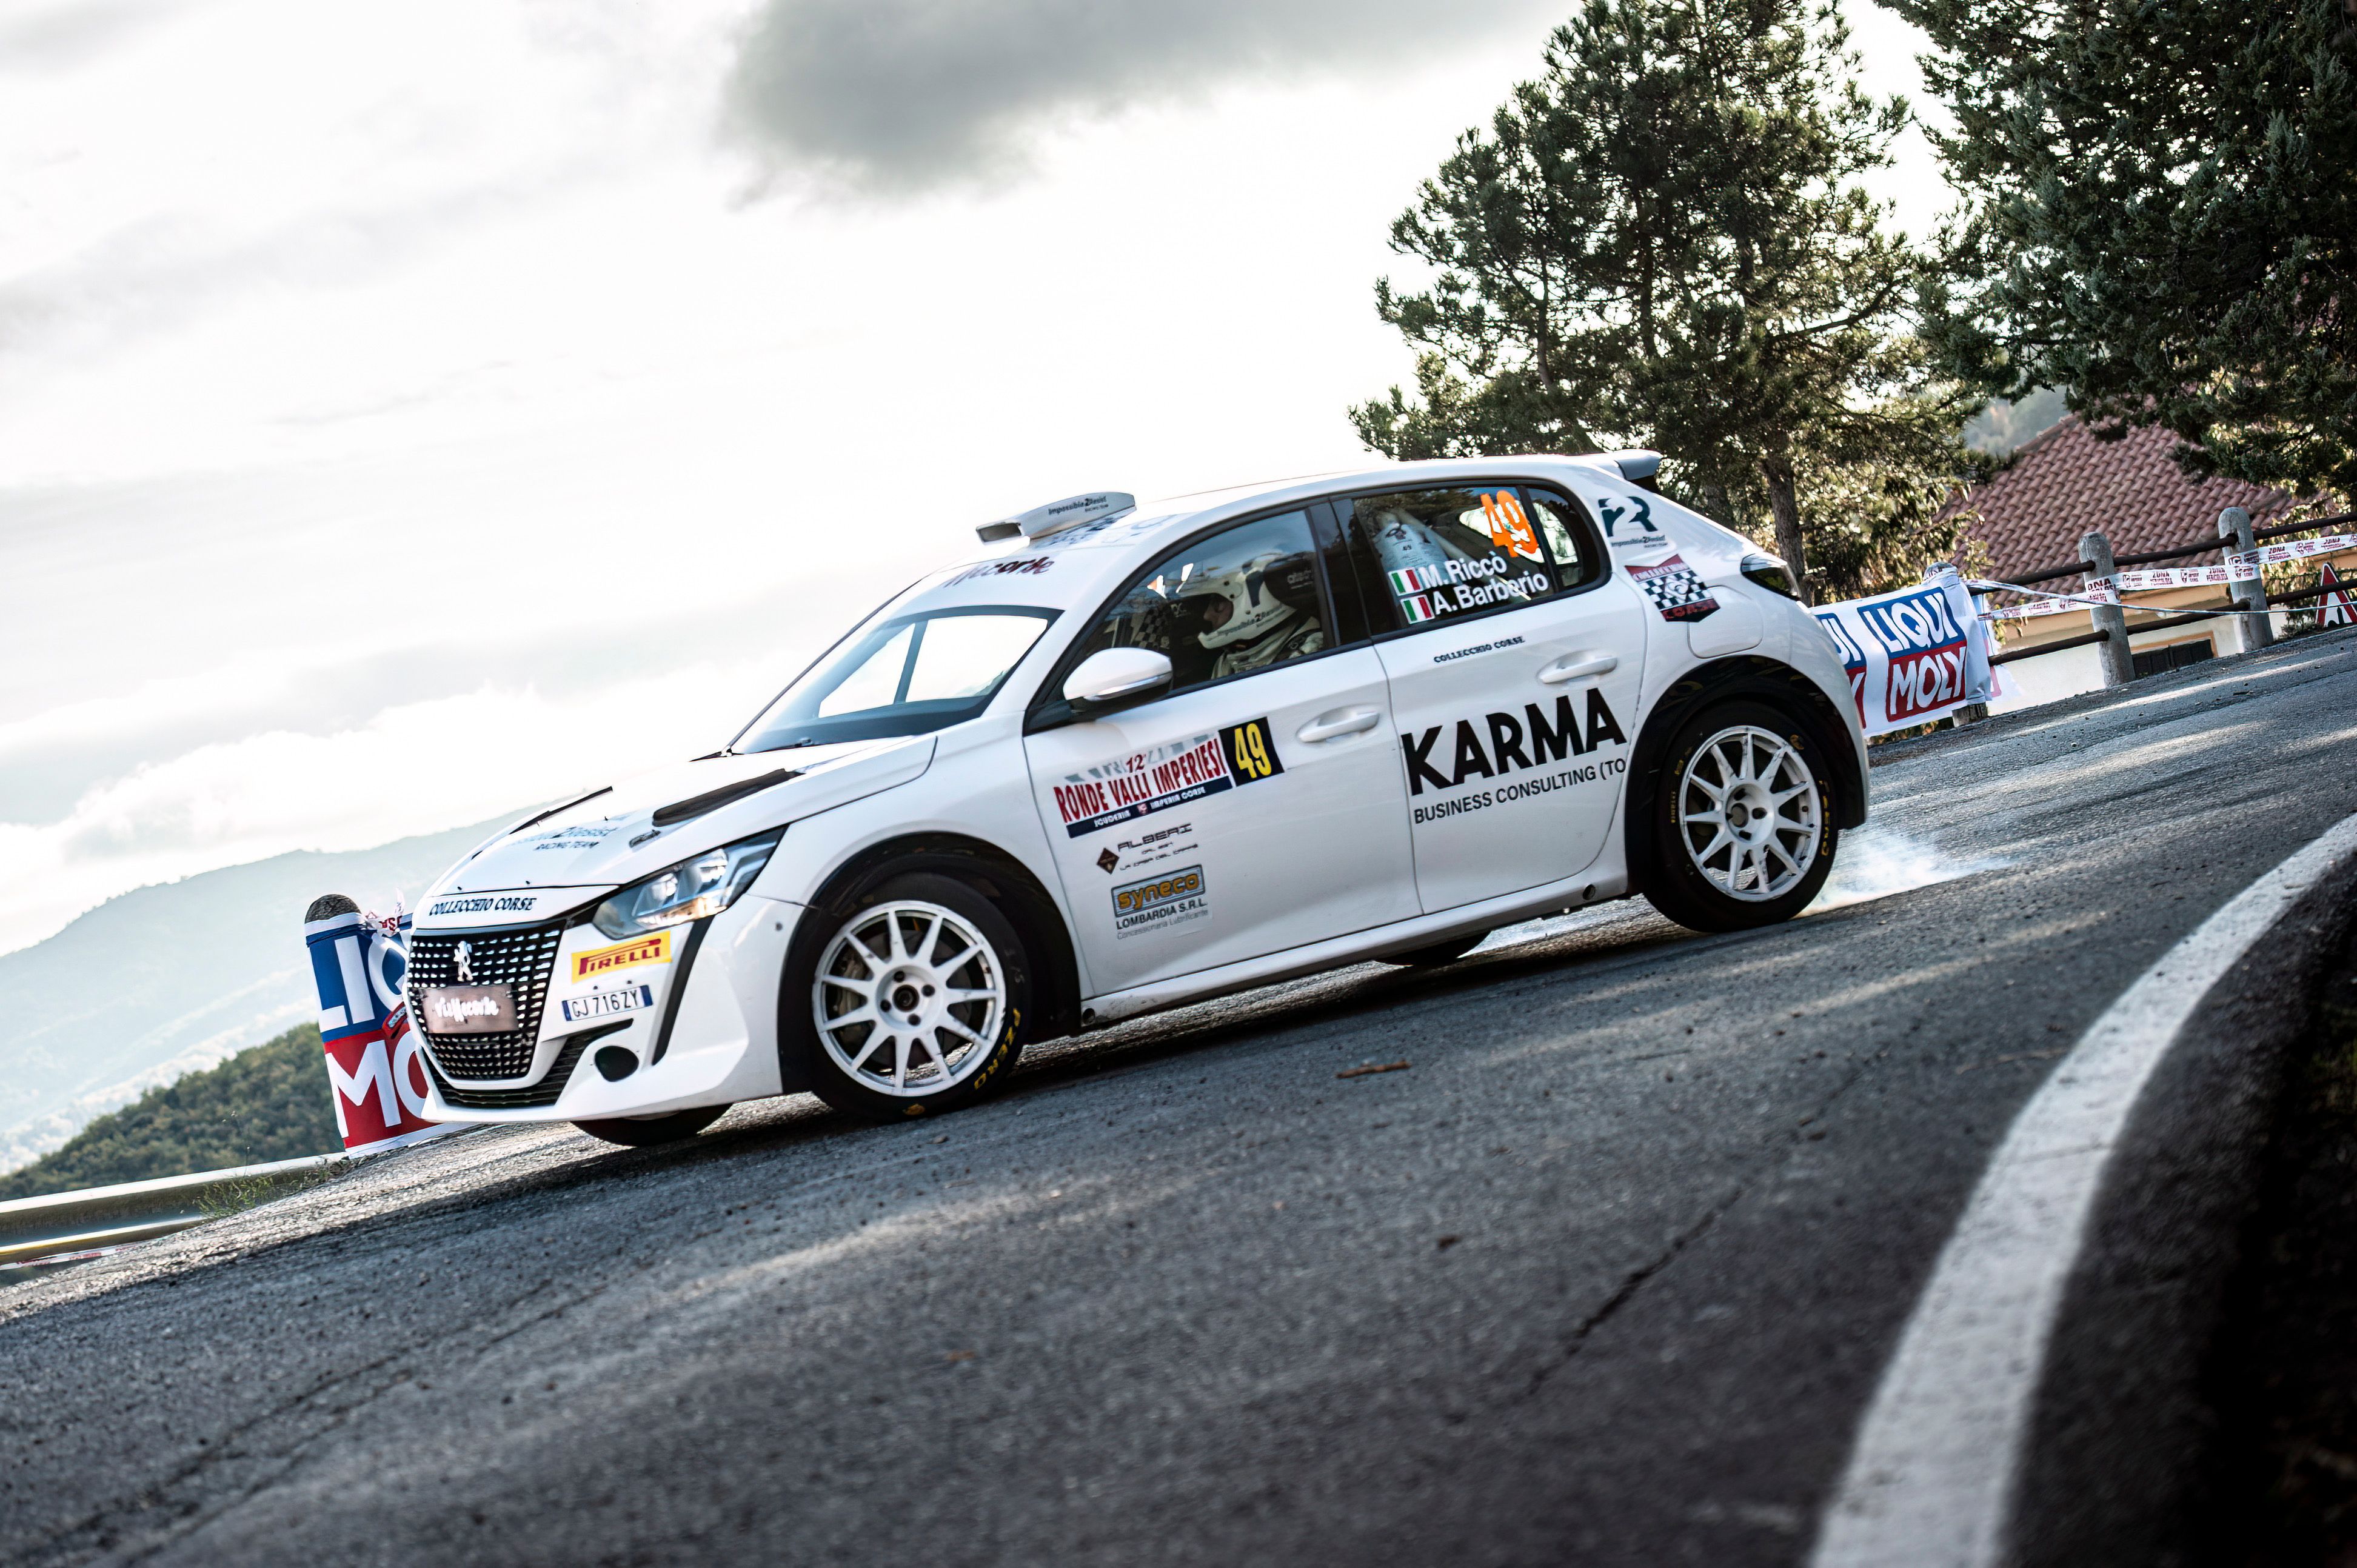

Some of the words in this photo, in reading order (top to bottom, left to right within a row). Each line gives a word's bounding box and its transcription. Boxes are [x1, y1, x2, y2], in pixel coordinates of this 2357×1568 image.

[1863, 593, 1958, 653] LIQUI
[1890, 646, 1966, 715] MOLY
[1234, 723, 1272, 778] 49
[1400, 687, 1627, 796] KARMA
[1053, 782, 1109, 824] RONDE
[1108, 772, 1152, 807] VALLI
[1152, 738, 1228, 794] IMPERIESI
[1414, 792, 1493, 824] BUSINESS
[1496, 766, 1596, 804] CONSULTING
[1116, 904, 1176, 930] LOMBARDIA
[1118, 873, 1199, 910] syneco
[307, 934, 409, 1033] LIQ
[579, 938, 661, 975] PIRELLI
[325, 1030, 427, 1138] MO
